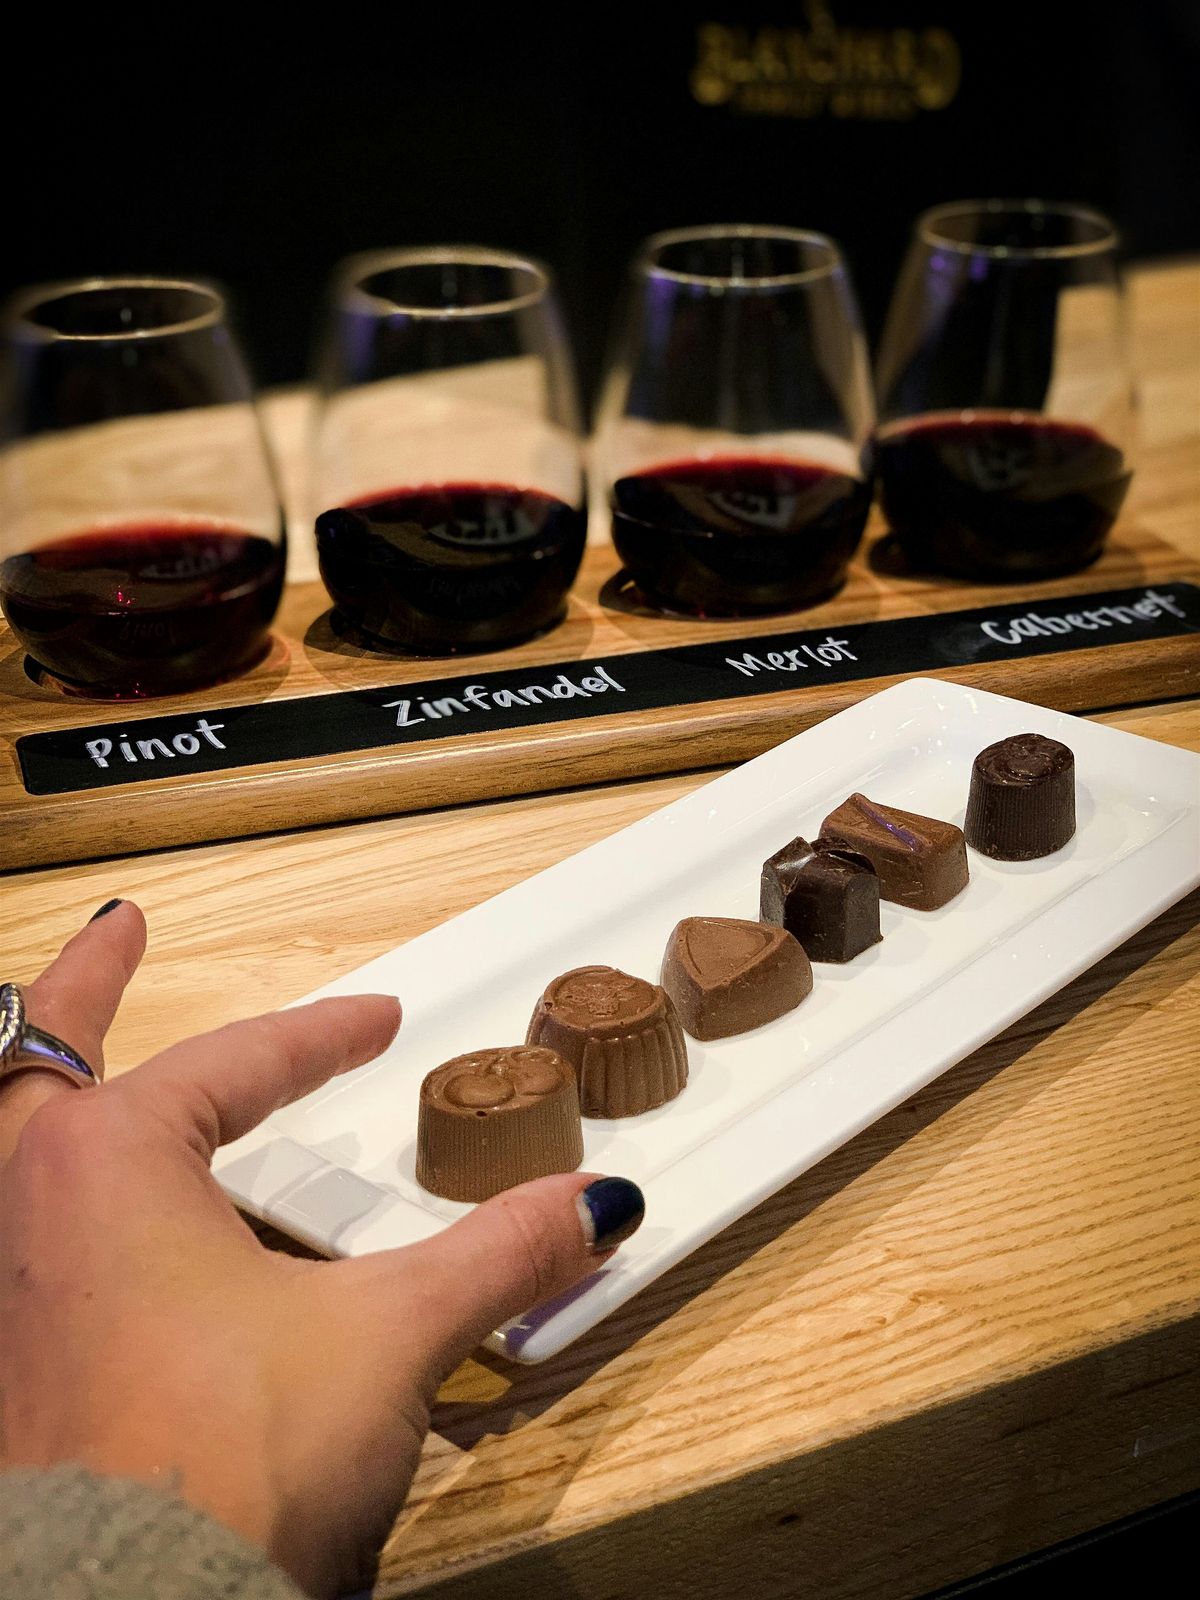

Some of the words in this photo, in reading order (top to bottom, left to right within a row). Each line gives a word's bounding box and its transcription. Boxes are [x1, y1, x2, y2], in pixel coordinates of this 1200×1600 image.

[85, 718, 227, 768] Pinot
[381, 665, 626, 727] Zinfandel
[725, 635, 859, 677] Merlot
[980, 590, 1186, 645] Cabernet
